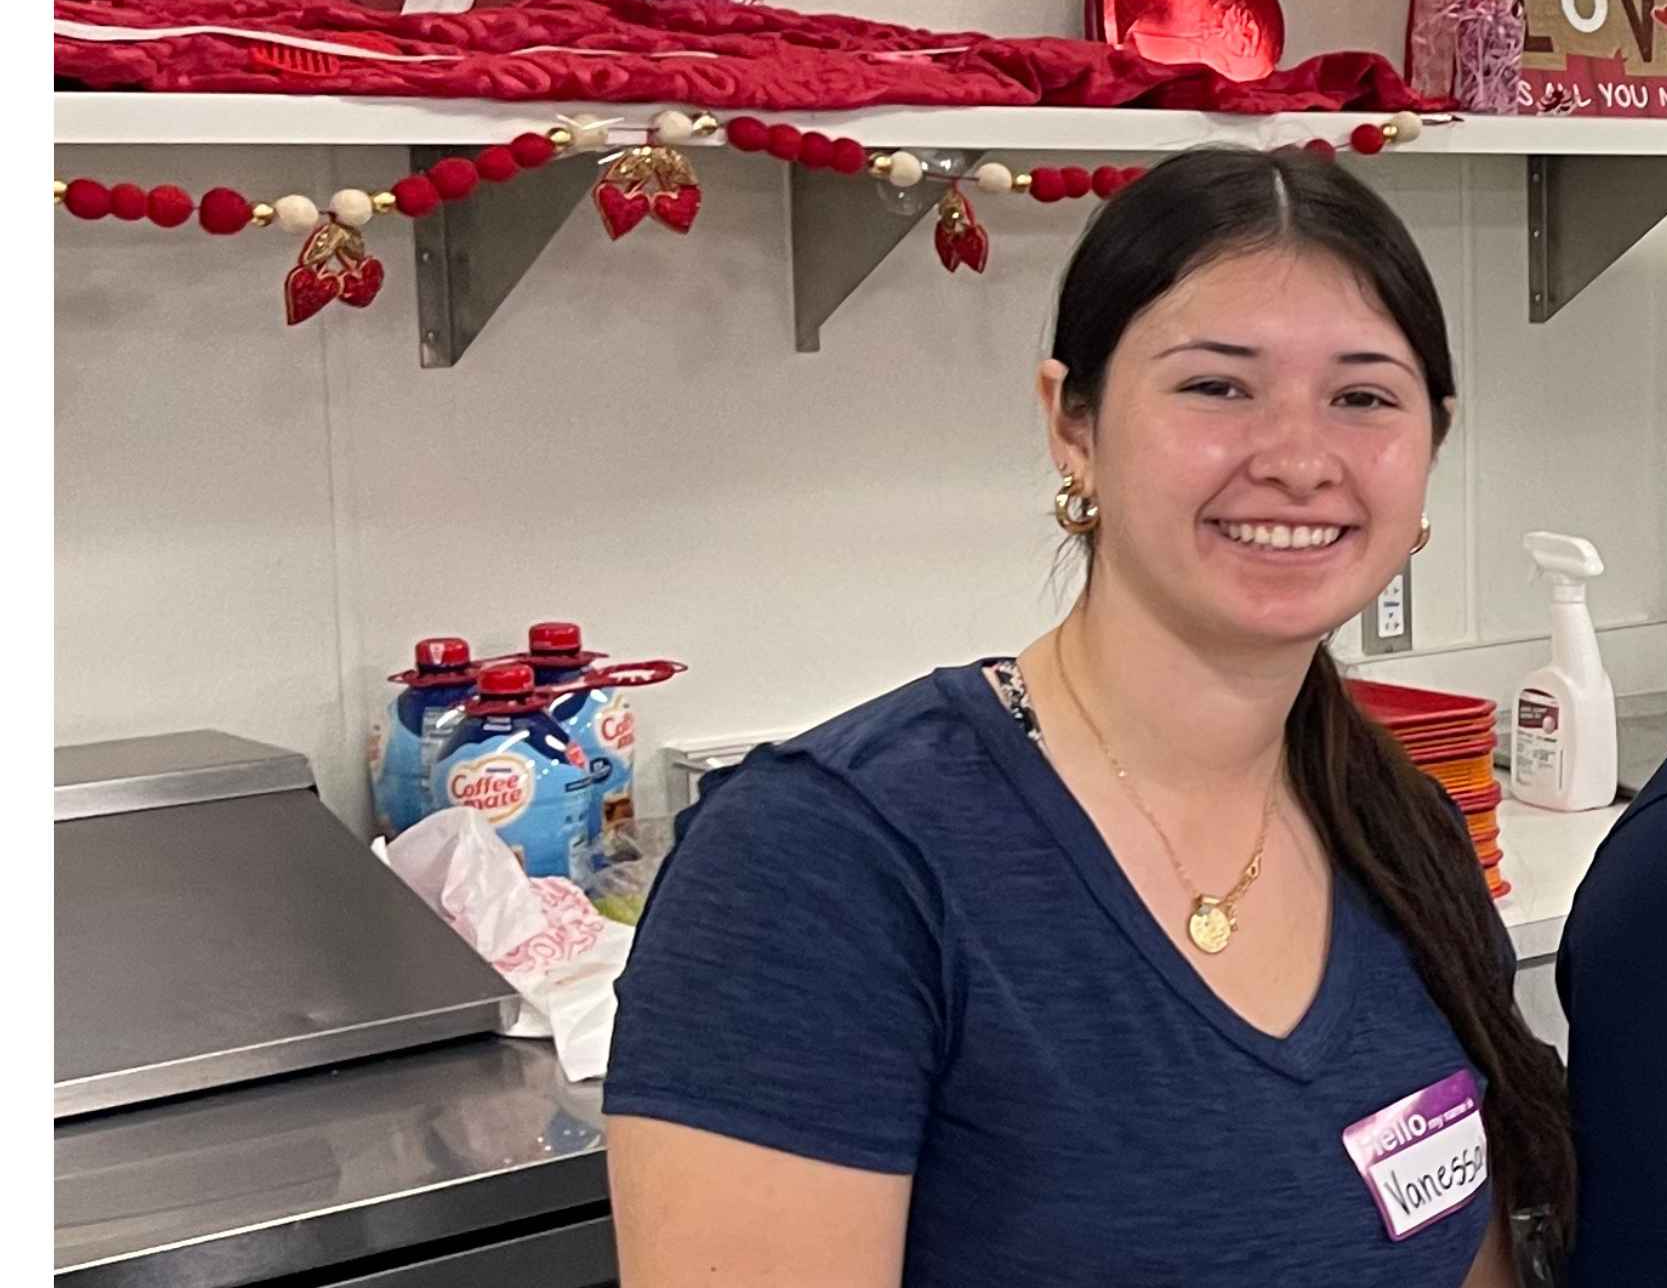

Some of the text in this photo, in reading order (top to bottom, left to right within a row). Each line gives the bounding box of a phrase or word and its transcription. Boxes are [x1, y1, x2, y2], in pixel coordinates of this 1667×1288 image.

[1598, 83, 1648, 108] YOU
[451, 773, 520, 800] Coffee
[463, 787, 524, 810] mate
